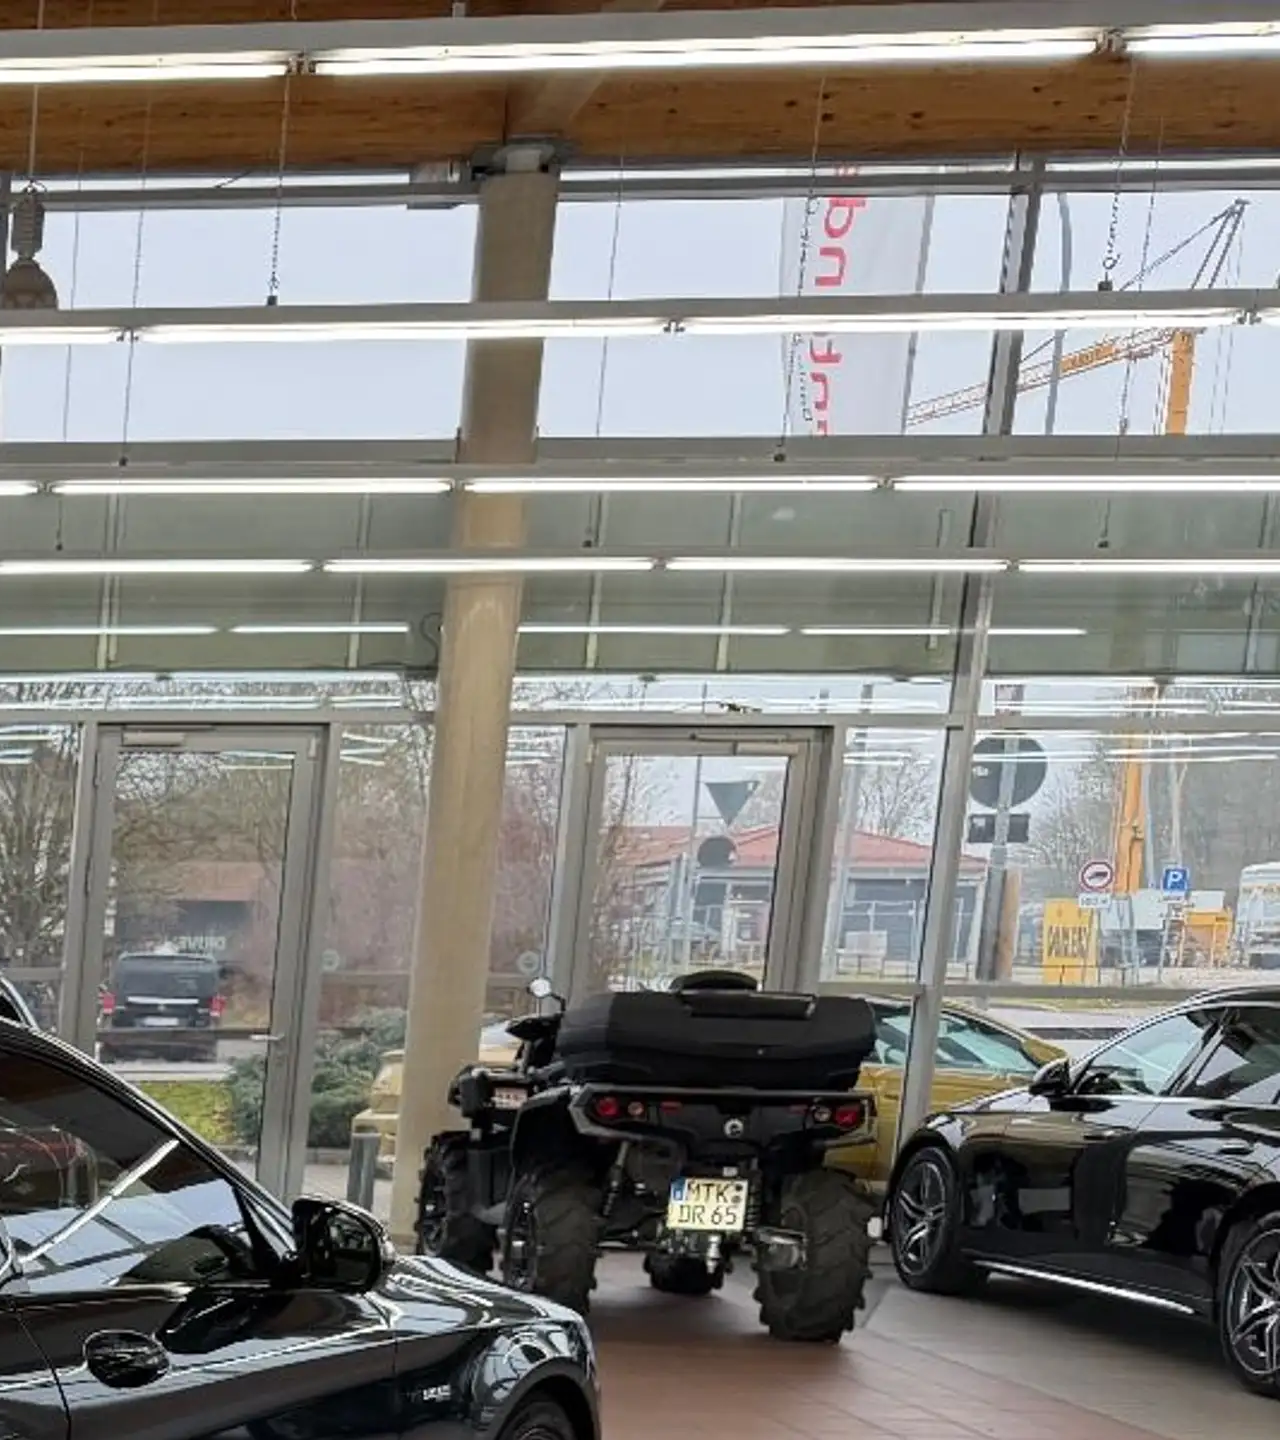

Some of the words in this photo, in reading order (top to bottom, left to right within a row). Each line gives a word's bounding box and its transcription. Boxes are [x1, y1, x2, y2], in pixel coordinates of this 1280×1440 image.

[1167, 871, 1183, 890] P
[687, 1183, 728, 1203] MTK
[678, 1205, 705, 1224] DR
[711, 1205, 737, 1225] 65
